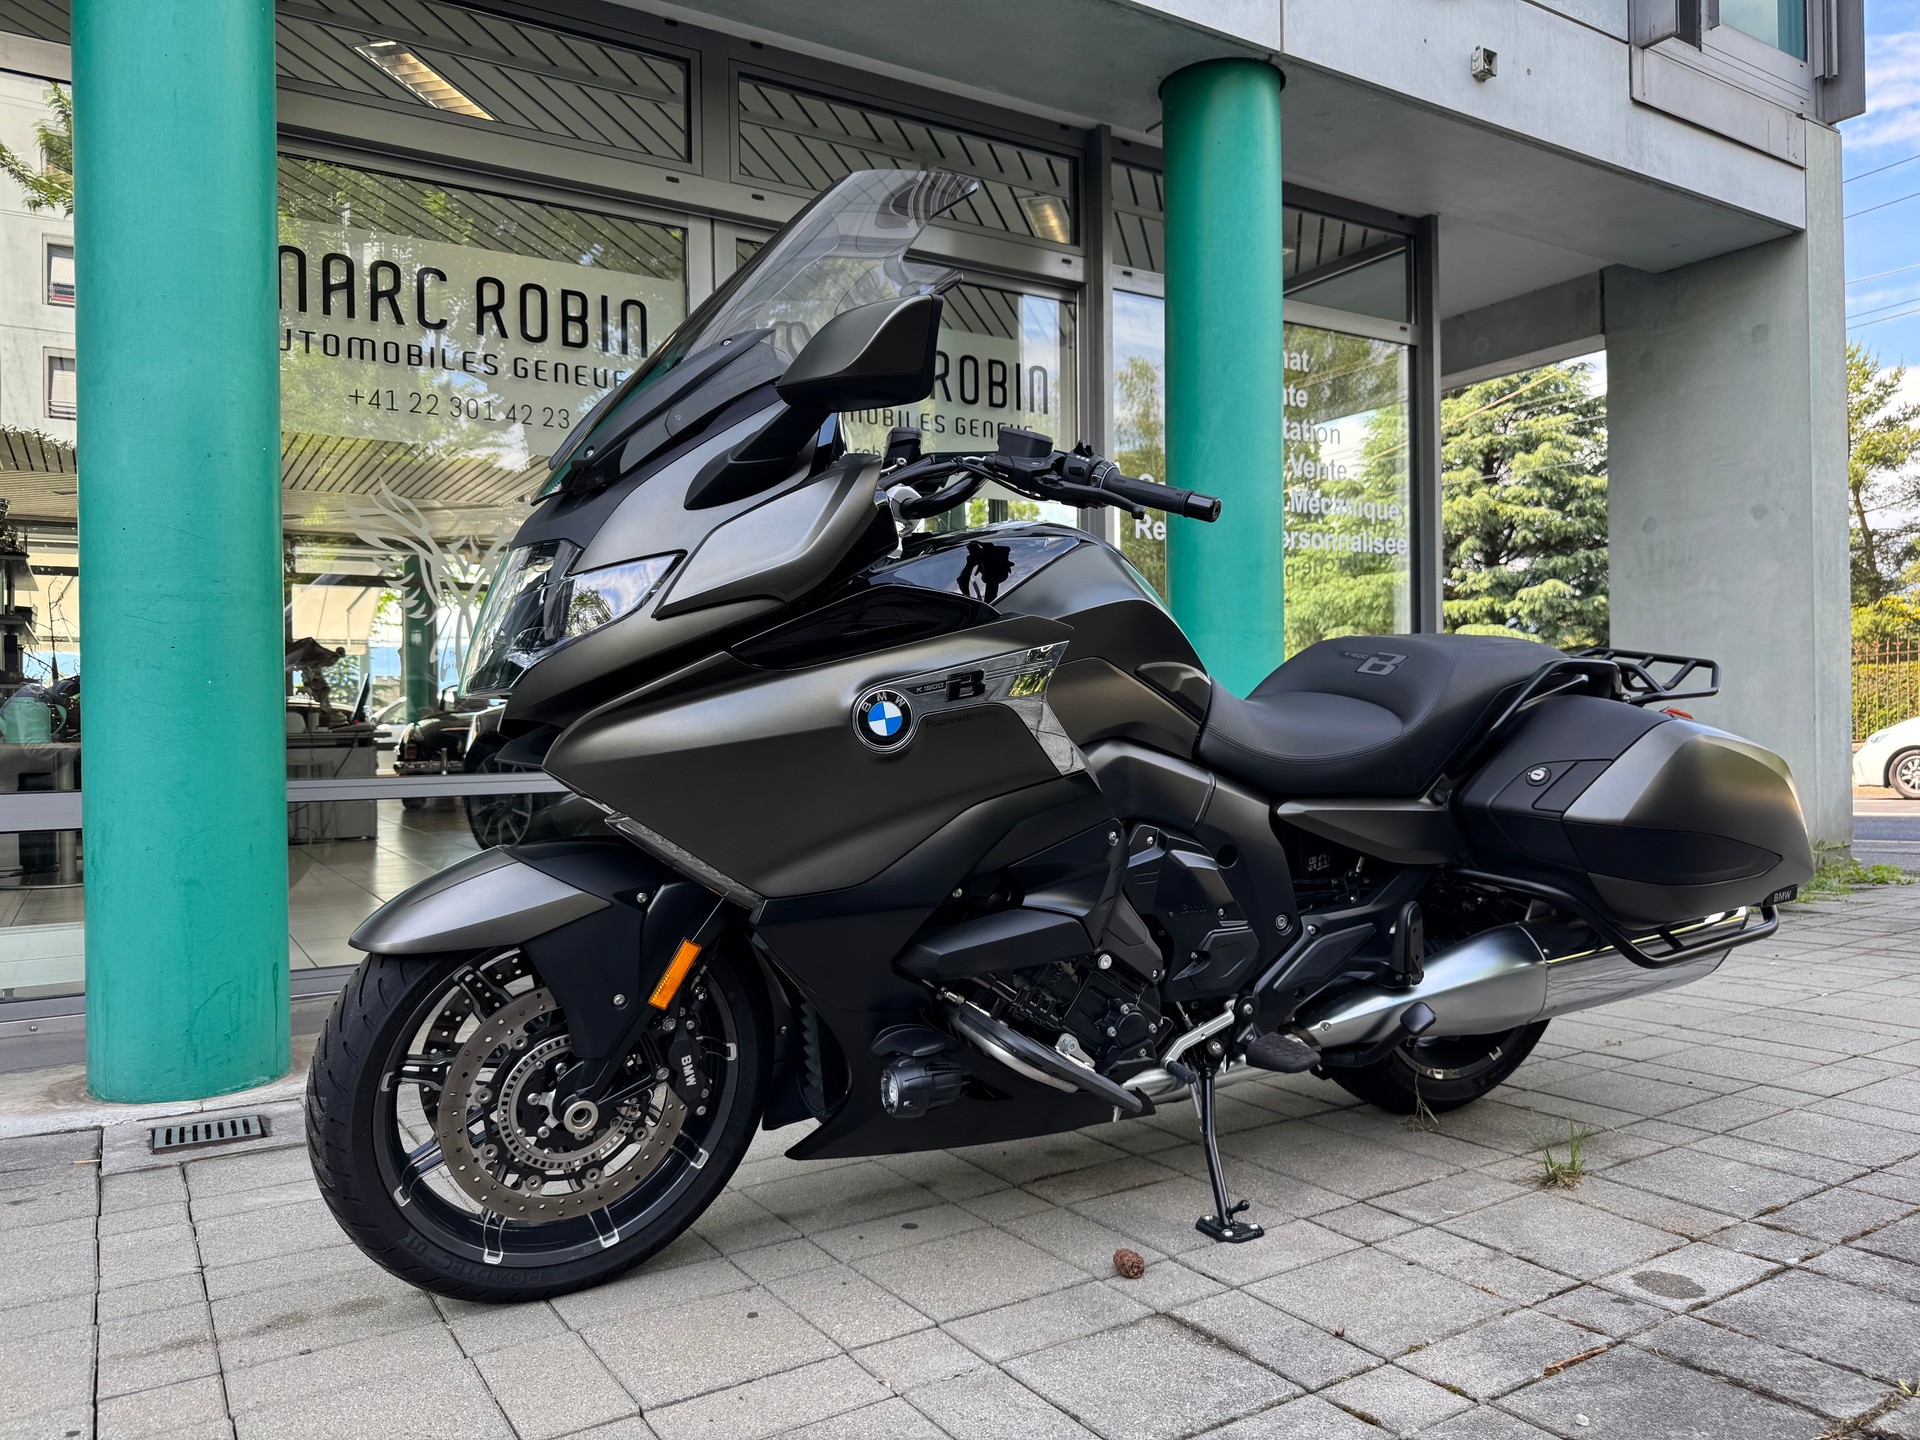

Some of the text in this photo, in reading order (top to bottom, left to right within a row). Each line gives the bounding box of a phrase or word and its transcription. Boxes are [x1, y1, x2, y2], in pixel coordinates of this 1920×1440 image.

[476, 276, 648, 358] ROBIN
[279, 328, 498, 376] UTOMOBILES
[348, 388, 570, 429] +41 22 301 42 23
[1289, 451, 1348, 481] Vente
[1290, 488, 1400, 525] Mécanique
[861, 691, 906, 713] BMW
[1773, 889, 1792, 902] BMW
[680, 1054, 697, 1087] BMW
